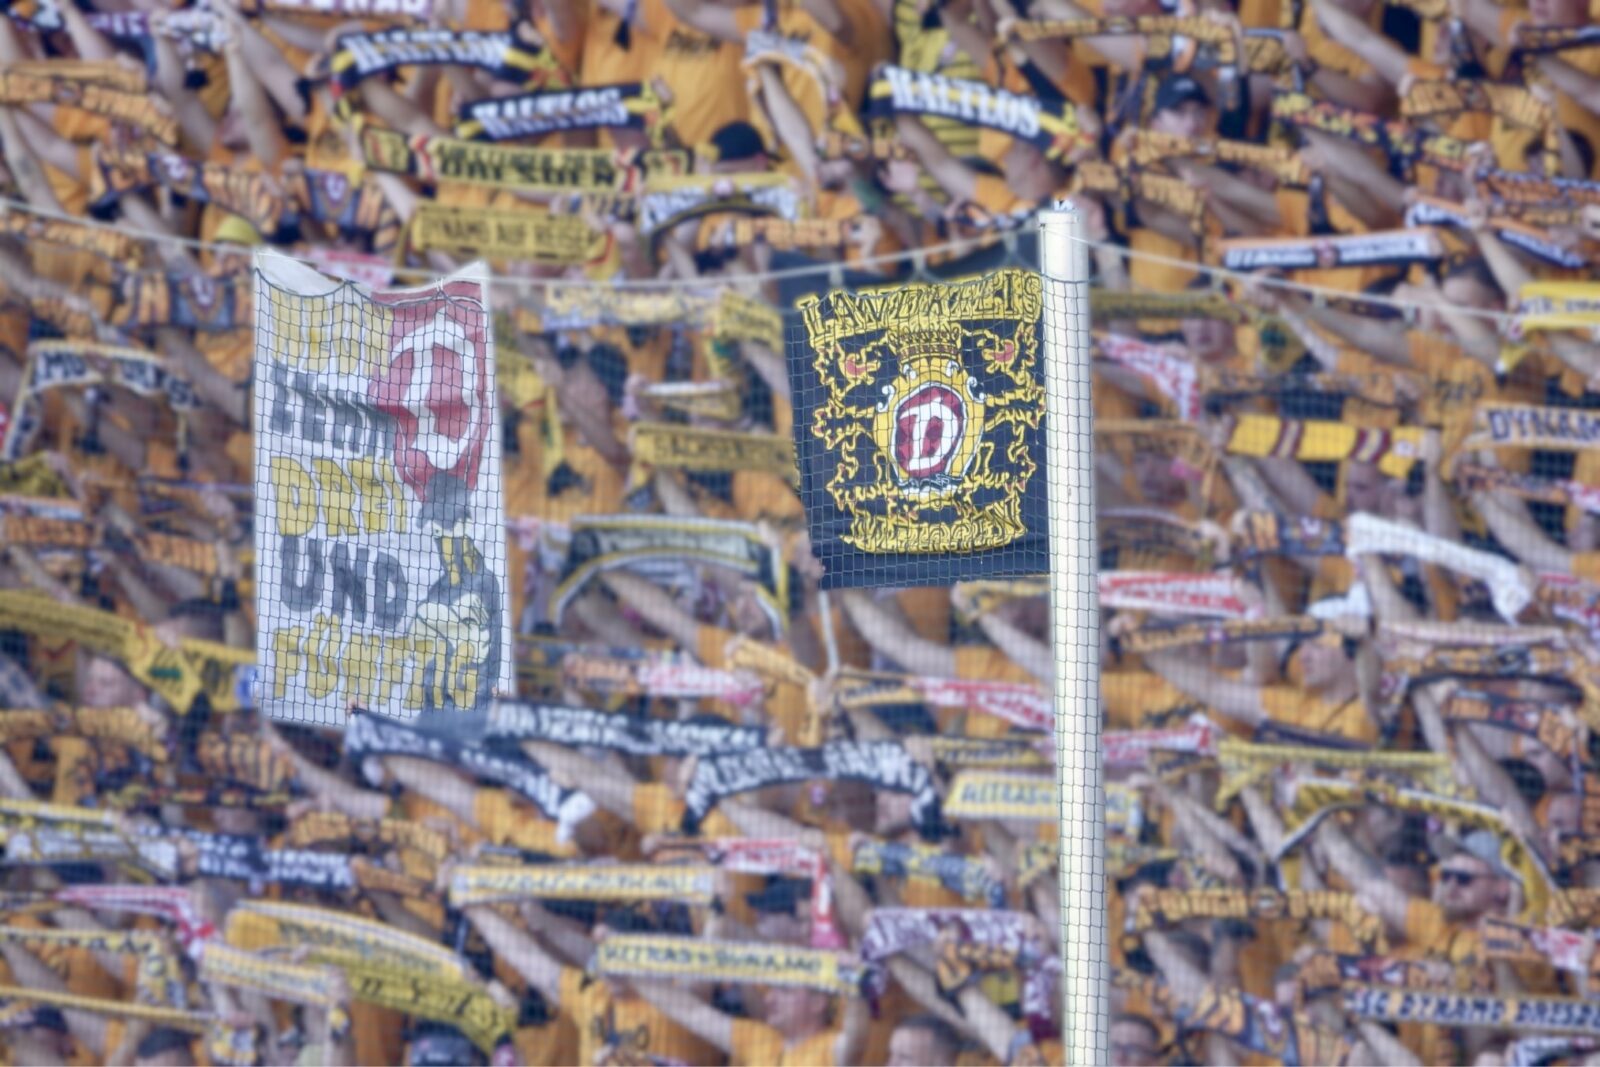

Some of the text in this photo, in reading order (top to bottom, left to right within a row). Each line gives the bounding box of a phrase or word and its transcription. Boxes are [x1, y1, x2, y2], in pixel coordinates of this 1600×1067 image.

[270, 455, 409, 537] DREI
[279, 534, 408, 629] UND
[272, 611, 479, 711] FÜNFZIG
